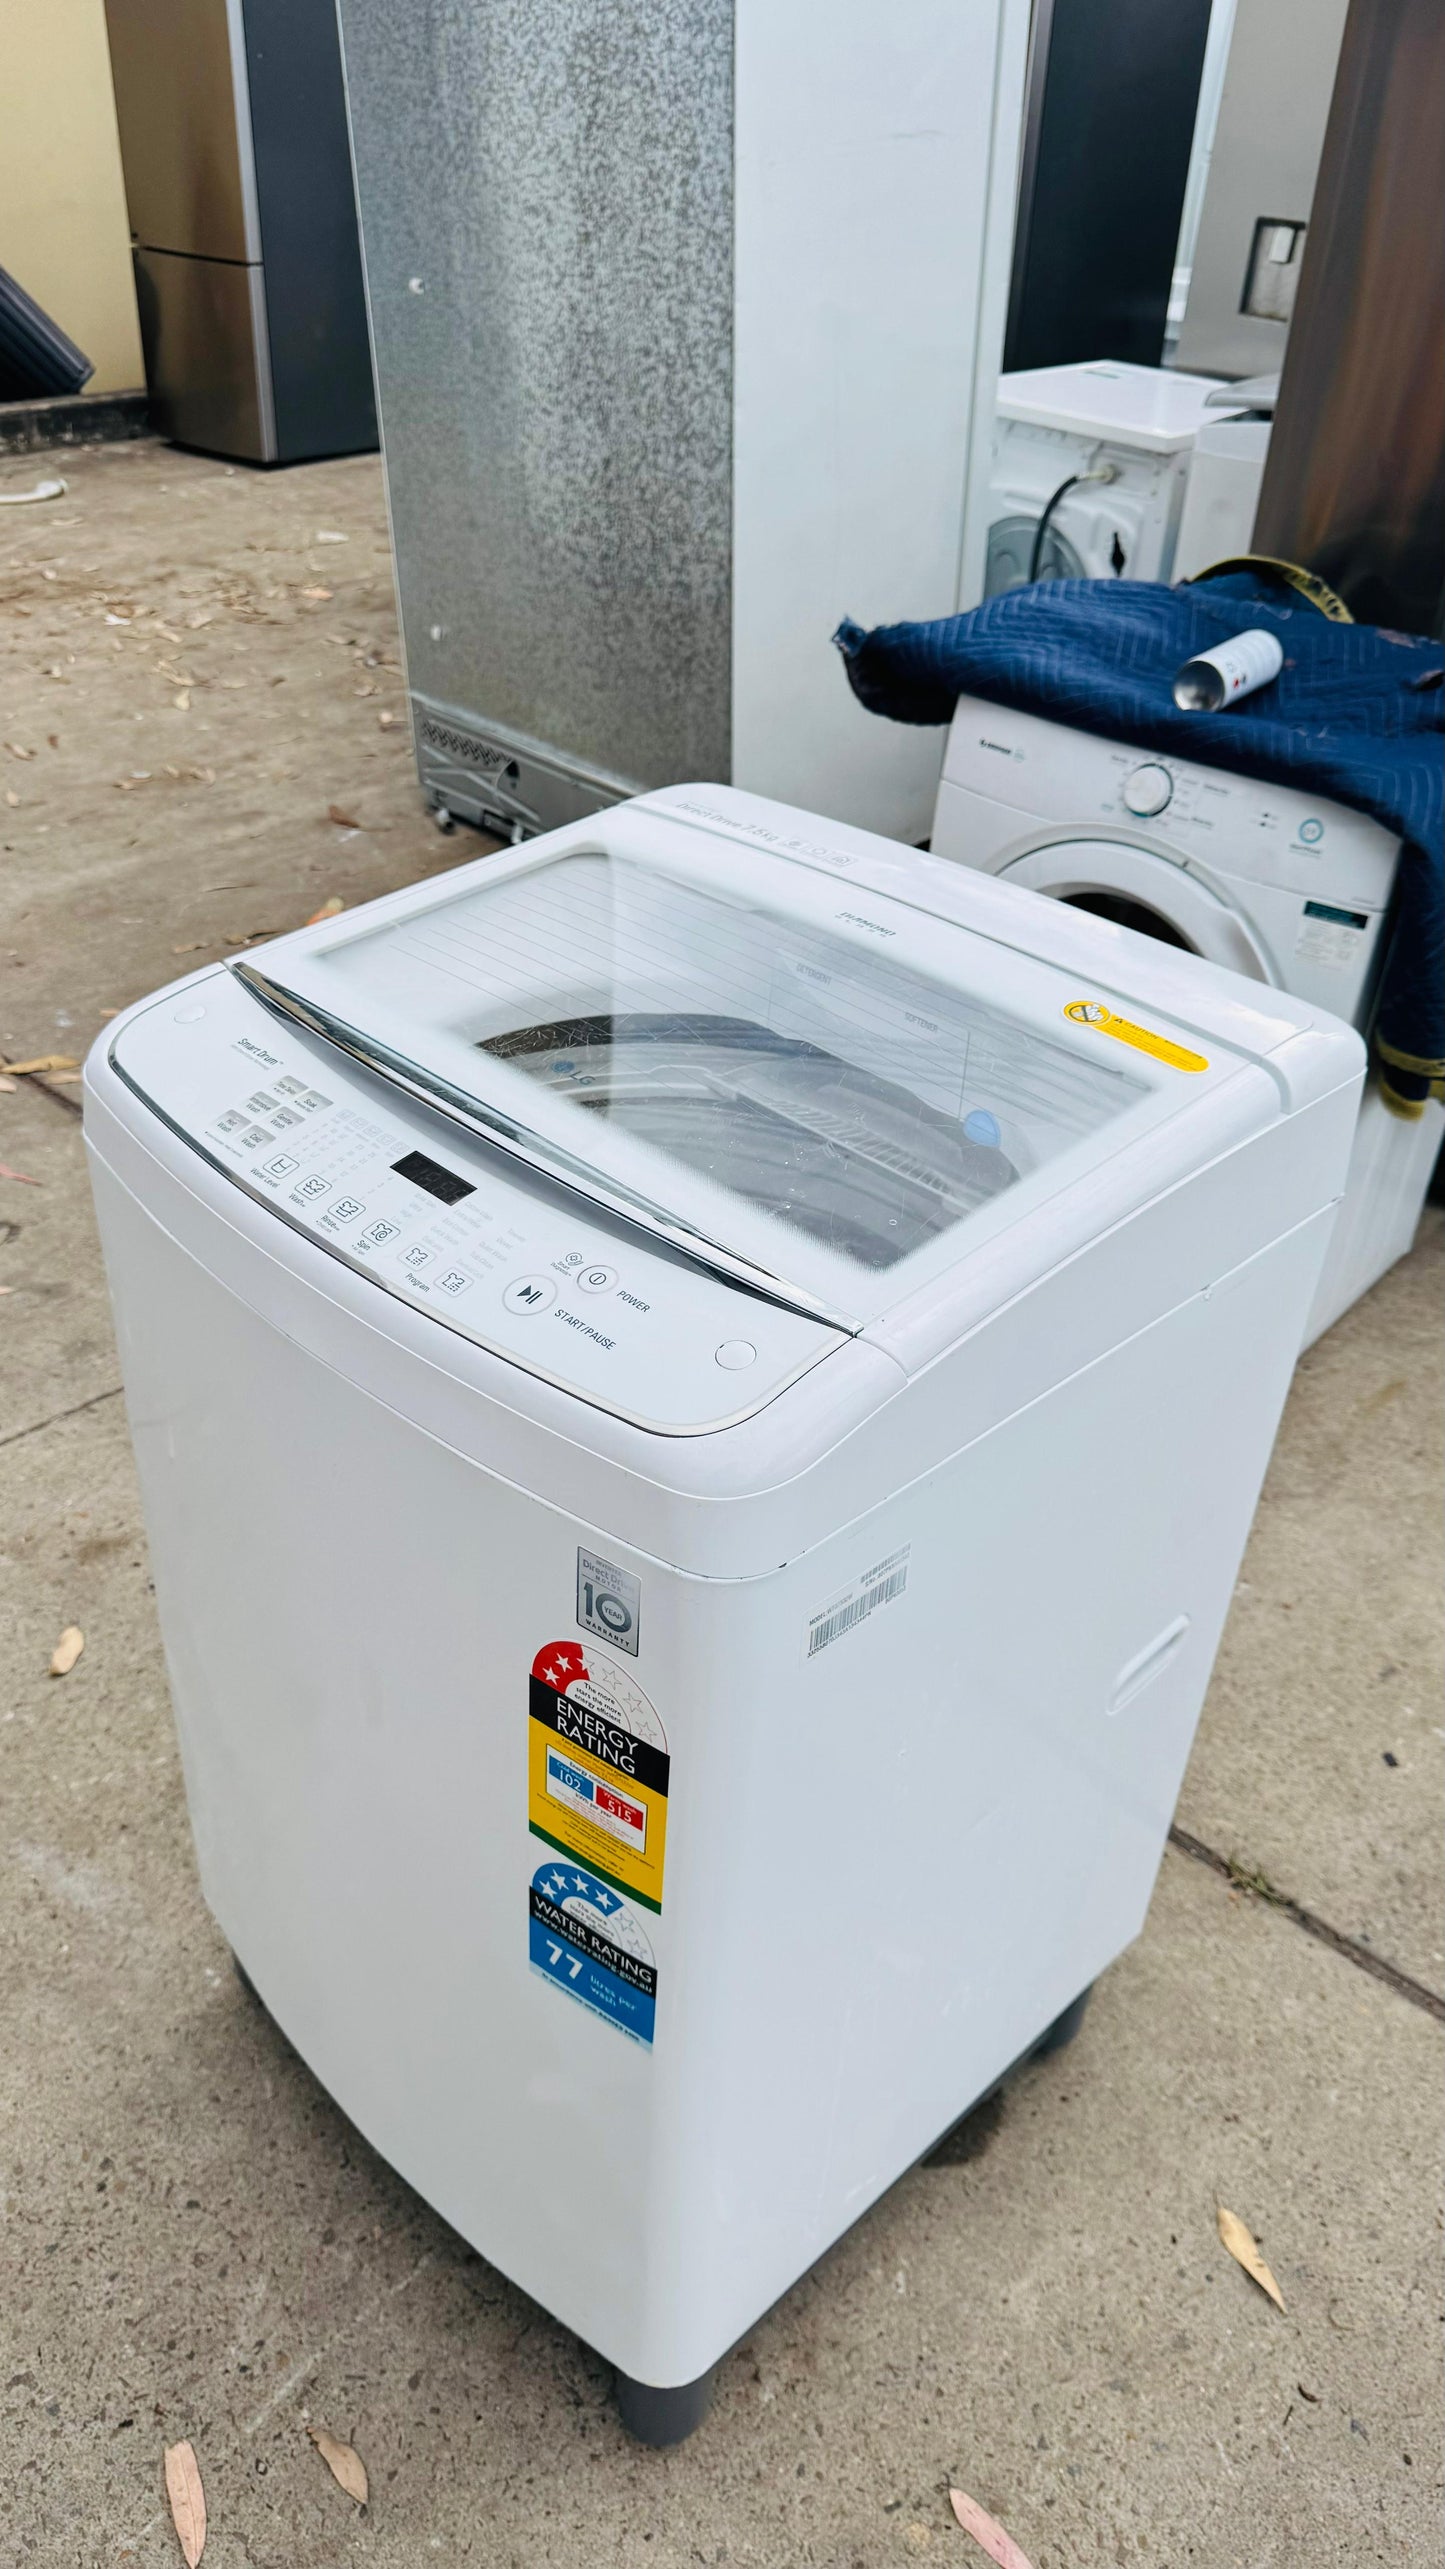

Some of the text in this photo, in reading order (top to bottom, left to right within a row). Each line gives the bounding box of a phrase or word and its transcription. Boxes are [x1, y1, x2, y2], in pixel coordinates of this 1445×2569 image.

[796, 963, 832, 985] DETERGENT
[904, 1012, 938, 1033] SOFTENER
[1125, 1022, 1159, 1040] CAUTION
[237, 1038, 261, 1054] Smart
[257, 1050, 279, 1065] Drum
[569, 1070, 596, 1085] LG
[250, 1168, 280, 1189] Water Level
[357, 1239, 371, 1251] Spin
[405, 1273, 430, 1293] Program
[616, 1290, 651, 1313] POWER
[554, 1308, 617, 1351] START/PAUSE
[583, 1559, 609, 1581] Direct
[595, 1575, 621, 1592] MOTOR
[583, 1582, 632, 1633] 10
[604, 1606, 623, 1621] YEAR
[585, 1618, 630, 1647] WARRANTY
[576, 1687, 621, 1716] stars the more
[584, 1682, 615, 1705] The more
[574, 1694, 621, 1724] energy efficient
[556, 1696, 639, 1756] ENERGY
[557, 1715, 635, 1775] RATING
[560, 1769, 581, 1793] 102
[569, 1761, 624, 1799] Energy consumption
[602, 1790, 621, 1805] Warm
[607, 1799, 632, 1824] 515
[535, 1895, 652, 1984] WATER RATING
[534, 1910, 653, 1994] www.waterrating.gov.au
[546, 1939, 584, 1980] 77
[590, 1987, 617, 2008] wash
[618, 1993, 638, 2011] per
